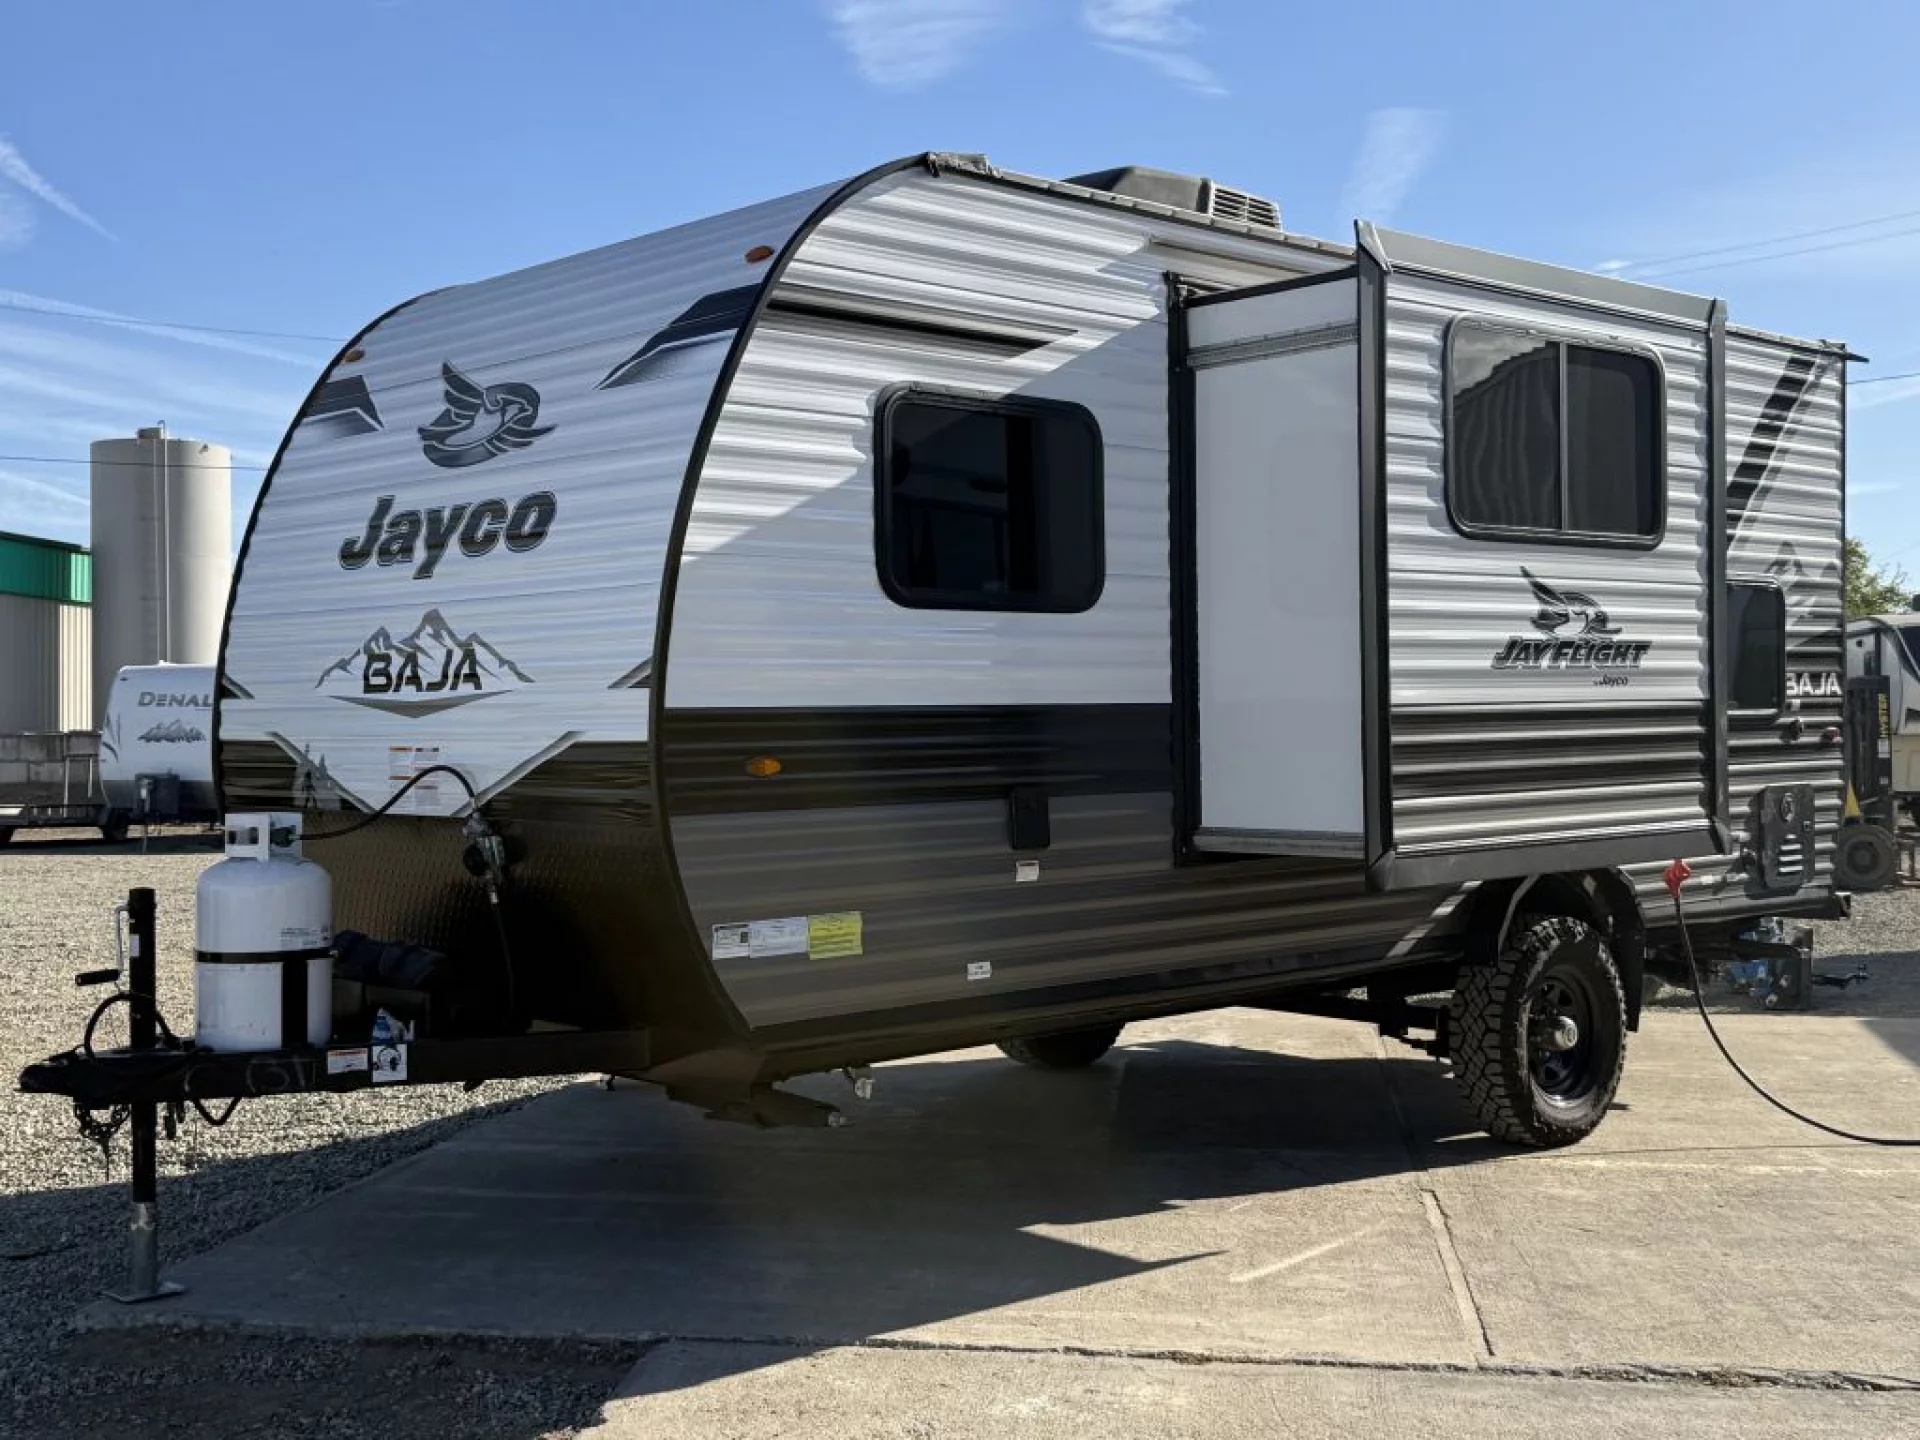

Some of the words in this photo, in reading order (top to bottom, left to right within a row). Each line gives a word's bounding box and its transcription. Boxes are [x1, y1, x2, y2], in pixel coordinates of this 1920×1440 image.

[338, 491, 557, 580] Jayco
[363, 646, 482, 694] BAJA
[1786, 672, 1842, 696] BAJA
